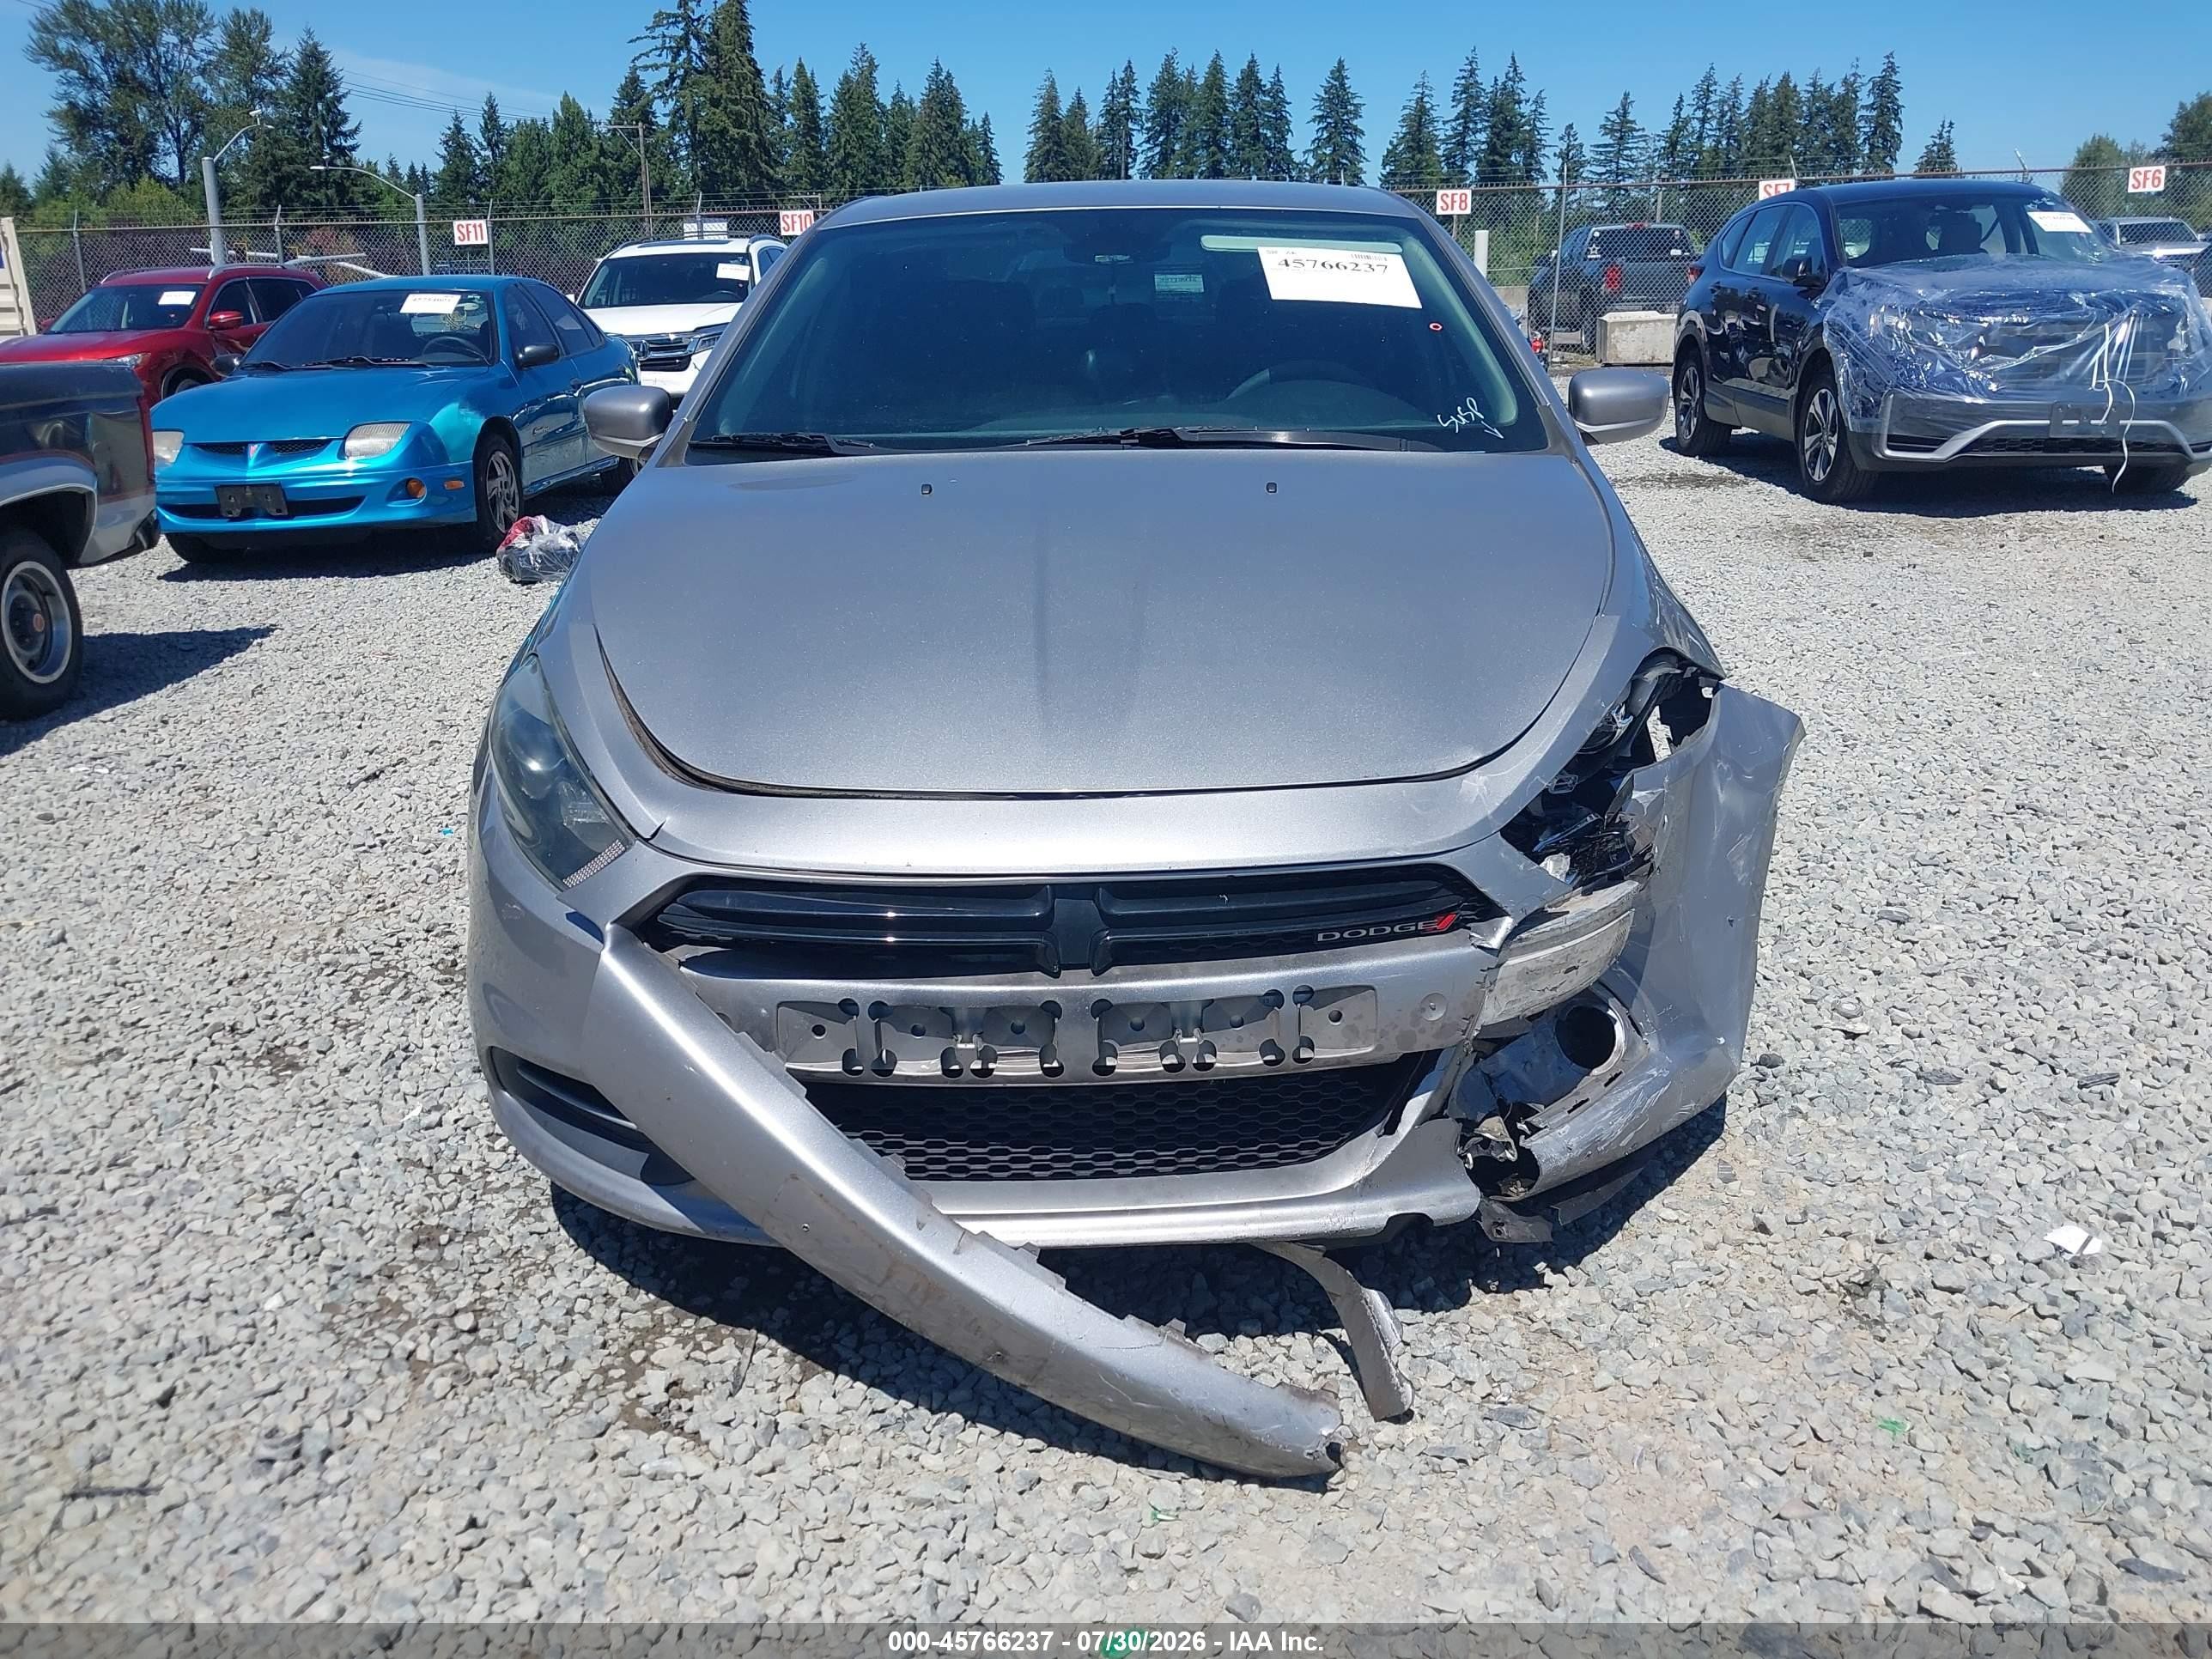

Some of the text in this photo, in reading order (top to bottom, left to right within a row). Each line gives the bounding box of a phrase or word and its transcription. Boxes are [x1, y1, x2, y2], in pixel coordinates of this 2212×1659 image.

[2131, 168, 2162, 189] SF6
[1440, 192, 1468, 211] SF8
[456, 223, 484, 242] SF11
[781, 214, 812, 232] SF10
[1277, 258, 1389, 275] 45766237
[1317, 919, 1438, 943] DODGE
